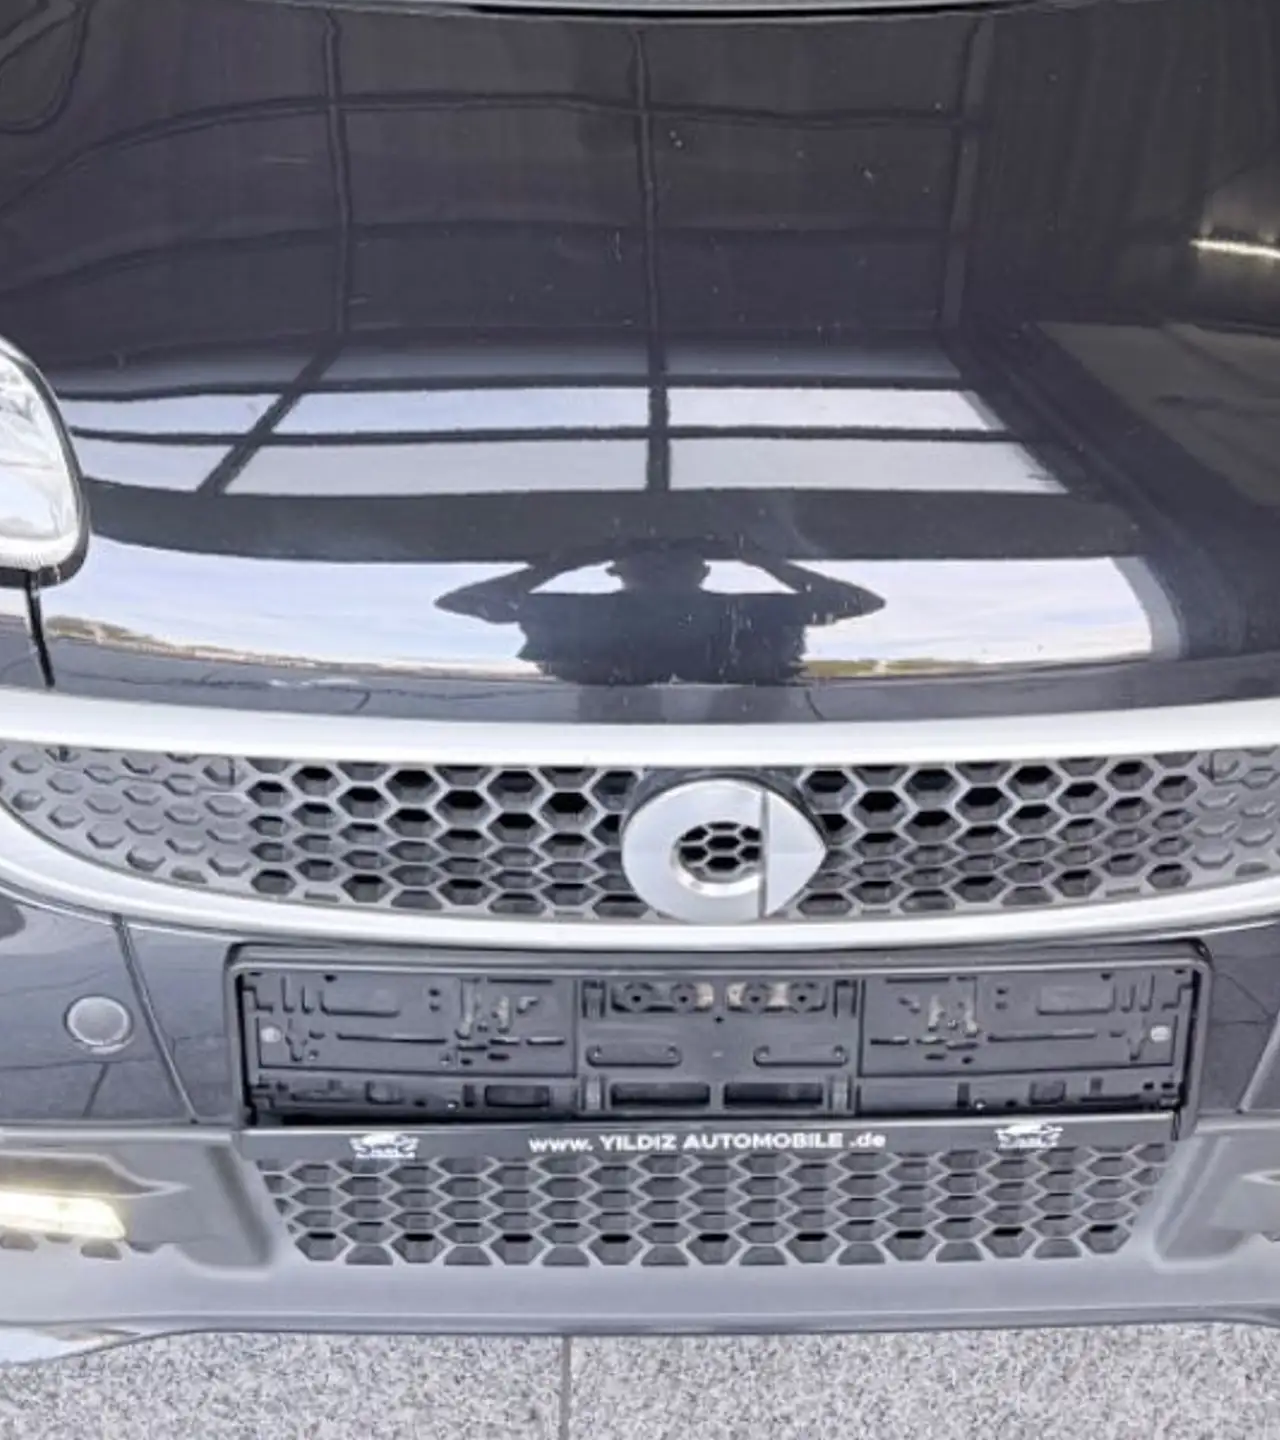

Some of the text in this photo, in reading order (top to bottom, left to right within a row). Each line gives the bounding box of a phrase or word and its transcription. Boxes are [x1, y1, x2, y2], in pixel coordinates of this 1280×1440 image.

[528, 1135, 593, 1153] www.
[599, 1133, 677, 1152] YILDIZ
[683, 1131, 844, 1150] AUTOMOBILE
